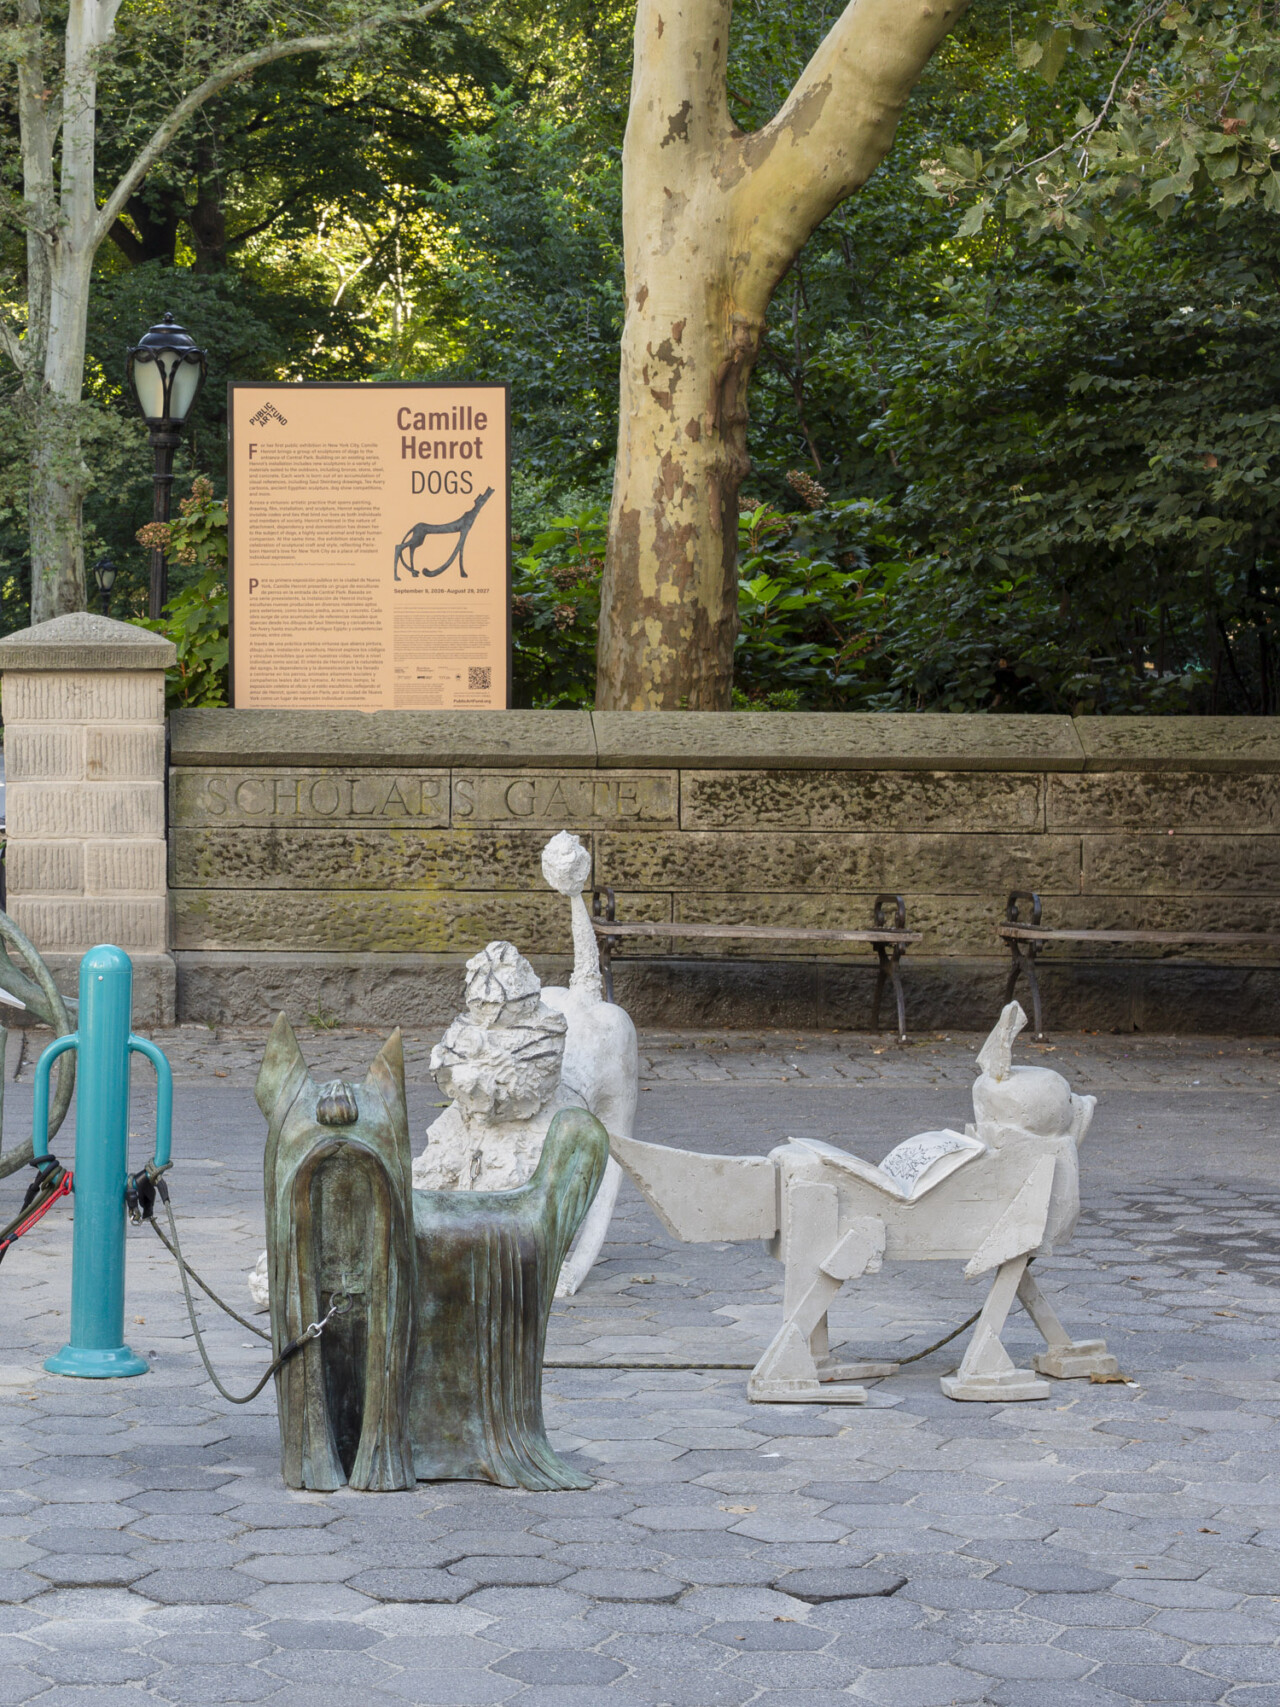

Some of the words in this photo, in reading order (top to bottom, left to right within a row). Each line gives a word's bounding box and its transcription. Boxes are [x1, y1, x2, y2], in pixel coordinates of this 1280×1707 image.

[249, 402, 272, 426] PUBLIC
[260, 412, 273, 427] ART
[269, 407, 288, 426] FUND
[397, 406, 488, 430] Camille
[402, 436, 483, 459] Henrot
[412, 470, 473, 494] DOGS
[207, 779, 475, 816] SCHOLARS
[504, 779, 644, 818] GATE
